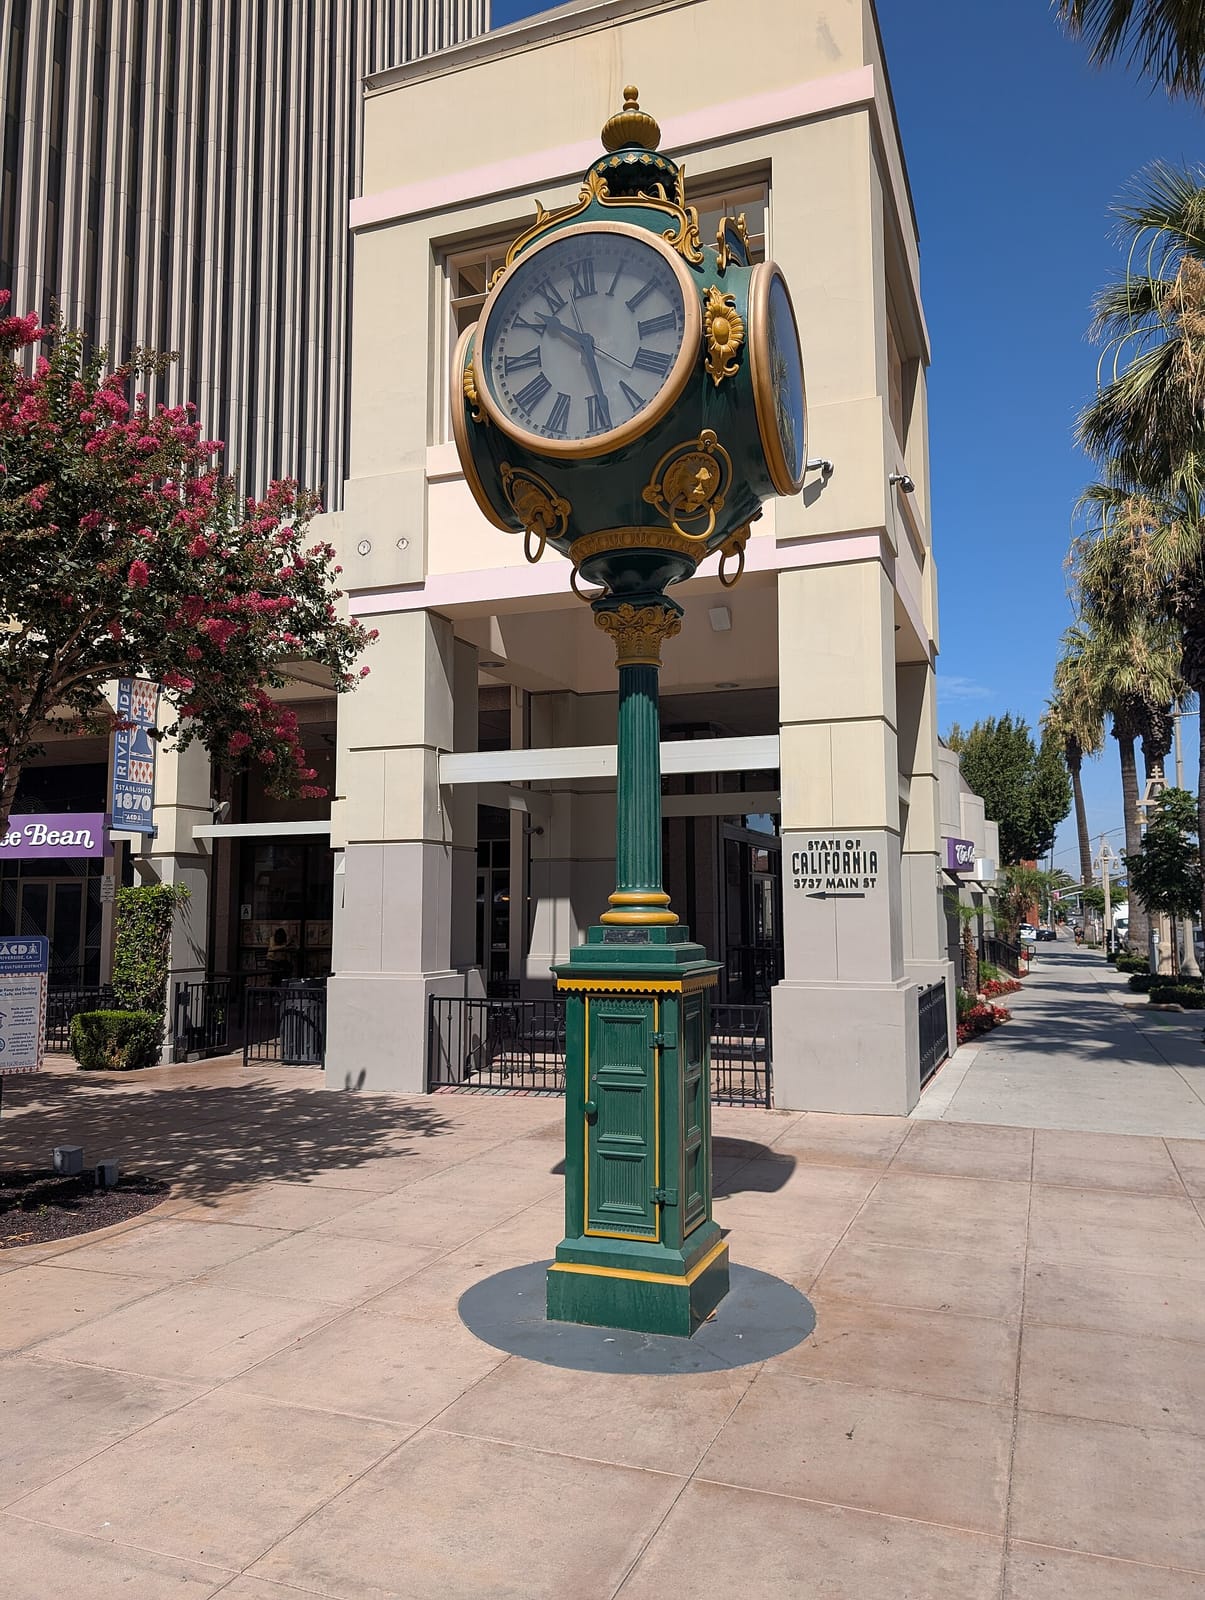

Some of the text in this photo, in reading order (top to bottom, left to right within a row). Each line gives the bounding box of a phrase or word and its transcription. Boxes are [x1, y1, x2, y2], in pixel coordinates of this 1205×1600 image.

[563, 257, 598, 299] XII
[533, 277, 568, 315] XI
[625, 276, 661, 312] II
[511, 313, 547, 337] X
[638, 310, 677, 340] III
[504, 345, 543, 376] IX
[632, 347, 674, 378] IIII
[512, 372, 552, 417] VIII
[619, 380, 646, 412] V
[542, 392, 571, 434] VII
[115, 783, 152, 794] ESTABLISHED
[115, 792, 152, 811] 1870
[24, 823, 95, 849] Bean
[807, 839, 861, 851] STATE OF
[792, 851, 878, 875] CALIFORNIA
[793, 877, 877, 889] 3737 MAIN ST
